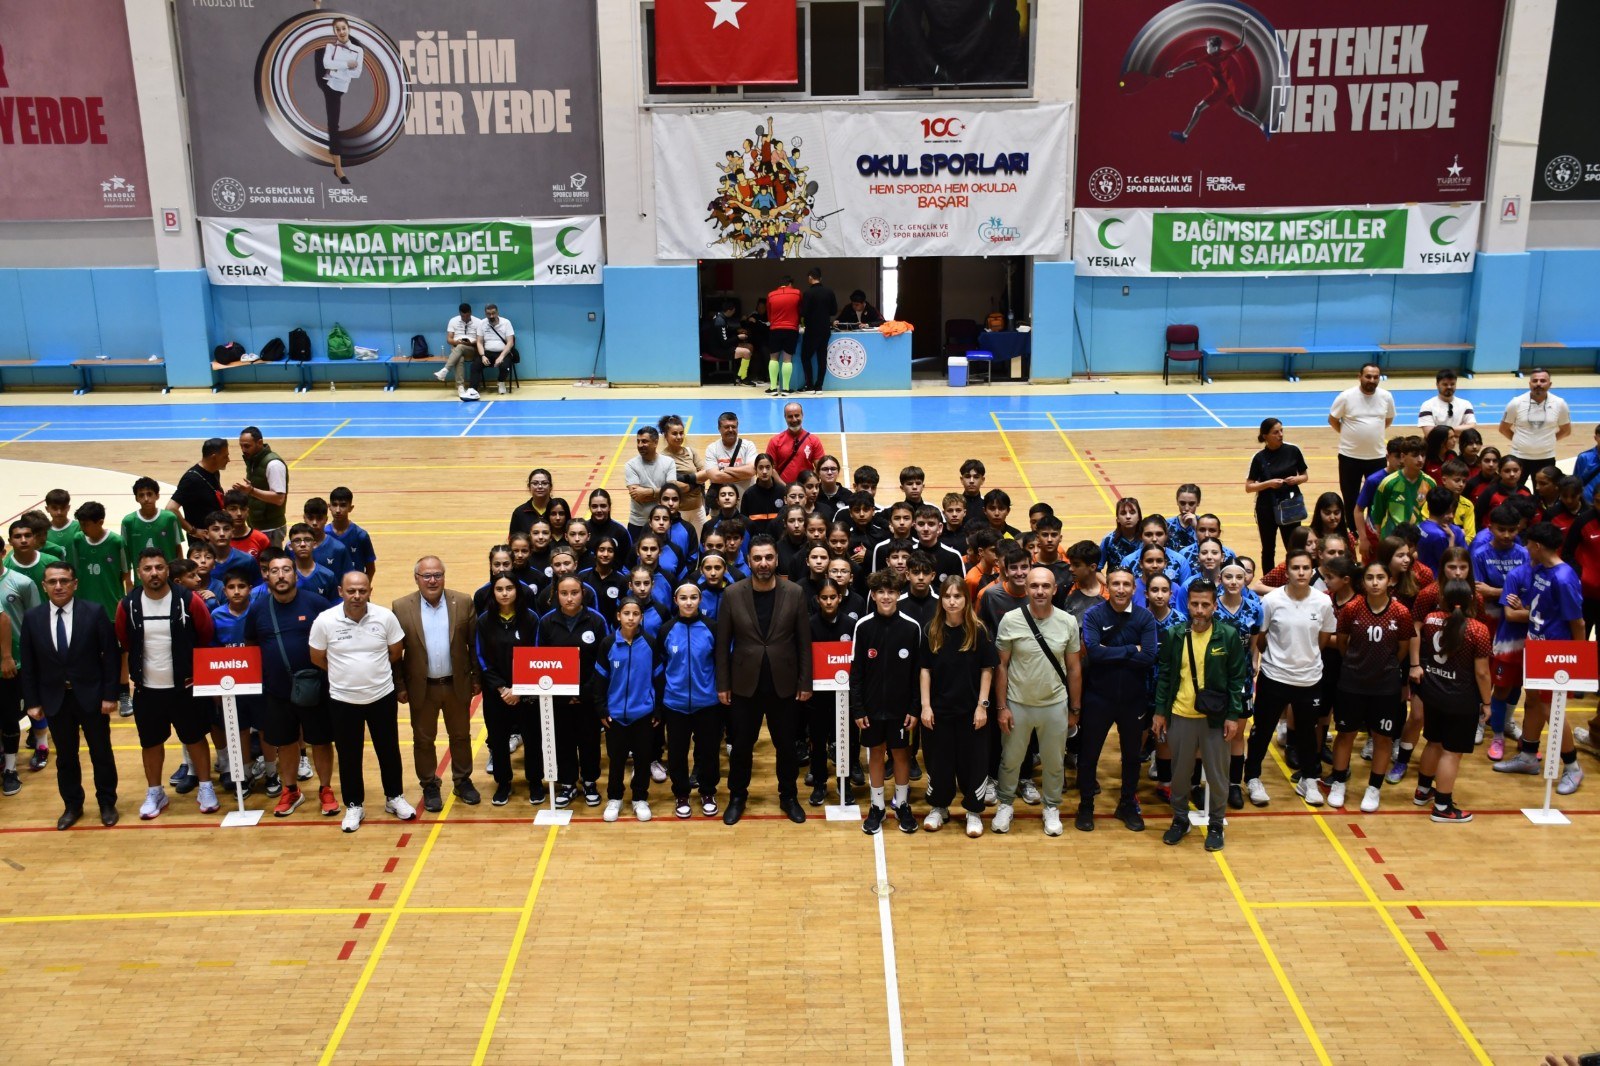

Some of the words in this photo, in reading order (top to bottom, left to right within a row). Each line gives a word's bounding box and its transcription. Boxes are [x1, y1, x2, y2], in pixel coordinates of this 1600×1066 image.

[399, 30, 517, 85] EĞİTİM
[1275, 24, 1429, 77] YETENEK
[403, 91, 466, 135] HER
[471, 89, 572, 134] YERDE
[1269, 85, 1338, 133] HER
[1348, 80, 1459, 131] YERDE
[856, 154, 918, 177] OKUL
[919, 152, 1030, 176] SPORLARI
[1144, 174, 1180, 184] GENÇLİK
[249, 186, 264, 194] T.C.
[266, 186, 302, 196] GENÇLİK
[870, 184, 894, 194] HEM
[896, 184, 942, 194] SPORDA
[944, 184, 968, 193] HEM
[971, 183, 1018, 192] OKULDA
[1149, 184, 1192, 192] BAKANLIĞI
[272, 196, 316, 204] BAKANLIĞI
[918, 196, 969, 210] BAŞARI
[1504, 202, 1516, 216] A
[165, 212, 177, 227] B
[1172, 219, 1274, 242] BAĞIMSIZ
[1279, 218, 1387, 241] NESİLLER
[292, 232, 387, 254] SAHADA
[392, 230, 520, 254] MÜCADELE,
[1087, 256, 1136, 269] YEŞİLAY
[1191, 244, 1234, 270] İÇİN
[1240, 242, 1366, 265] SAHADAYIZ
[1420, 252, 1471, 265] YEŞİLAY
[218, 265, 269, 278] YEŞİLAY
[317, 254, 419, 277] HAYATTA
[424, 254, 499, 276] İRADE!
[547, 264, 597, 278] YEŞİLAY
[88, 564, 100, 574] 10
[1367, 626, 1382, 642] 10
[210, 659, 248, 670] MANİSA
[530, 660, 562, 668] KONYA
[1545, 654, 1578, 664] AYDIN
[1380, 718, 1392, 731] 10
